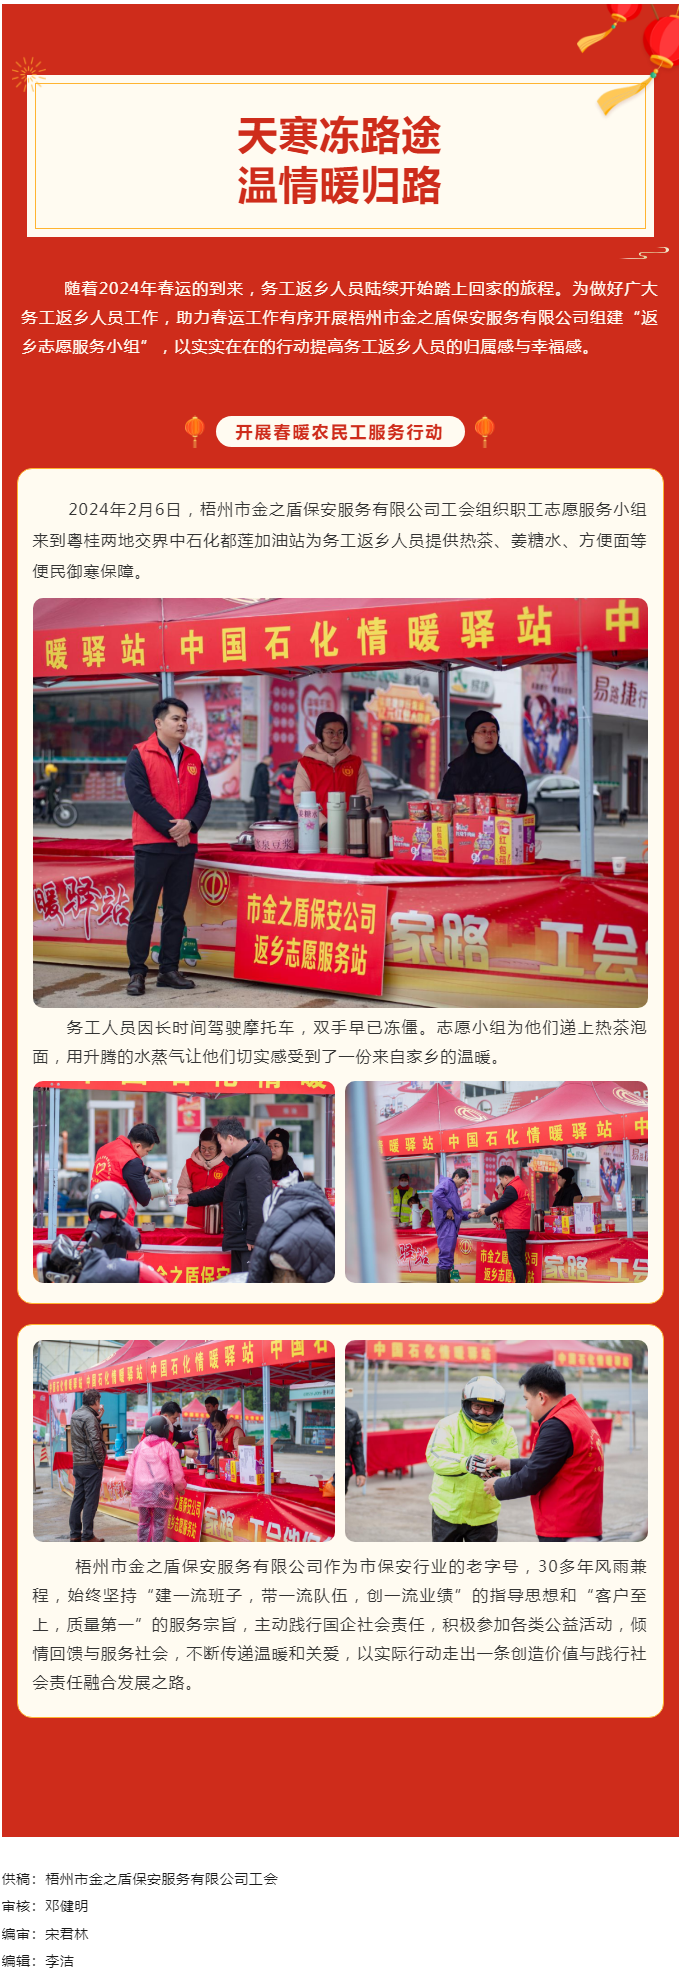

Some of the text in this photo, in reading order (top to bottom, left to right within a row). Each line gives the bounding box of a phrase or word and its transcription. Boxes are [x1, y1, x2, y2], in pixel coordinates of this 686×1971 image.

[237, 115, 442, 155] 天寒冻路途
[237, 164, 442, 206] 温情暖归路
[64, 279, 659, 297] 随着2024年春运的到来，务工返乡人员陆续开始踏上回家的旅程。为做好广大
[235, 423, 443, 442] 开展春暖农民工服务行动
[68, 500, 648, 518] 2024年2月6日，梧州市金之盾保安服务有限公司工会组织职工志愿服务小组
[31, 531, 648, 549] 来到粤桂两地交界中石化都莲加油站为务工返乡人员提供热茶、姜糖水、方便面等
[31, 563, 141, 580] 便民御寒保障。
[45, 599, 640, 670] 暖驿站 中国石化情暖驿站 中
[247, 892, 376, 935] 市金之盾保安公司
[390, 909, 490, 970] 家路
[253, 933, 367, 976] 返乡志愿服务站
[66, 1018, 648, 1036] 务工人员因长时间驾驶摩托车，双手早已冻僵。志愿小组为他们递上热茶泡
[32, 1047, 498, 1066] 面，用升腾的水蒸气让他们切实感受到了一份来自家乡的温暖。
[448, 1119, 613, 1150] 中国石化情暖驿站
[543, 1254, 588, 1281] 家路
[86, 1364, 143, 1388] 中国石化情暖驿站
[150, 1340, 254, 1380] 中国石化情暖驿站
[74, 1557, 648, 1575] 梧州市金之盾保安服务有限公司作为市保安行业的老字号，30多年风雨兼
[31, 1644, 648, 1662] 情回馈与服务社会，不断传递温暖和关爱，以实际行动走出一条创造价值与践行社
[31, 1673, 192, 1691] 会责任融合发展之路。
[1, 1872, 279, 1887] 供稿：梧州市金之盾保安服务有限公司工会
[1, 1899, 89, 1913] 审核：邓健明
[1, 1927, 90, 1941] 编审：宋君林
[1, 1953, 75, 1969] 编辑：李洁
